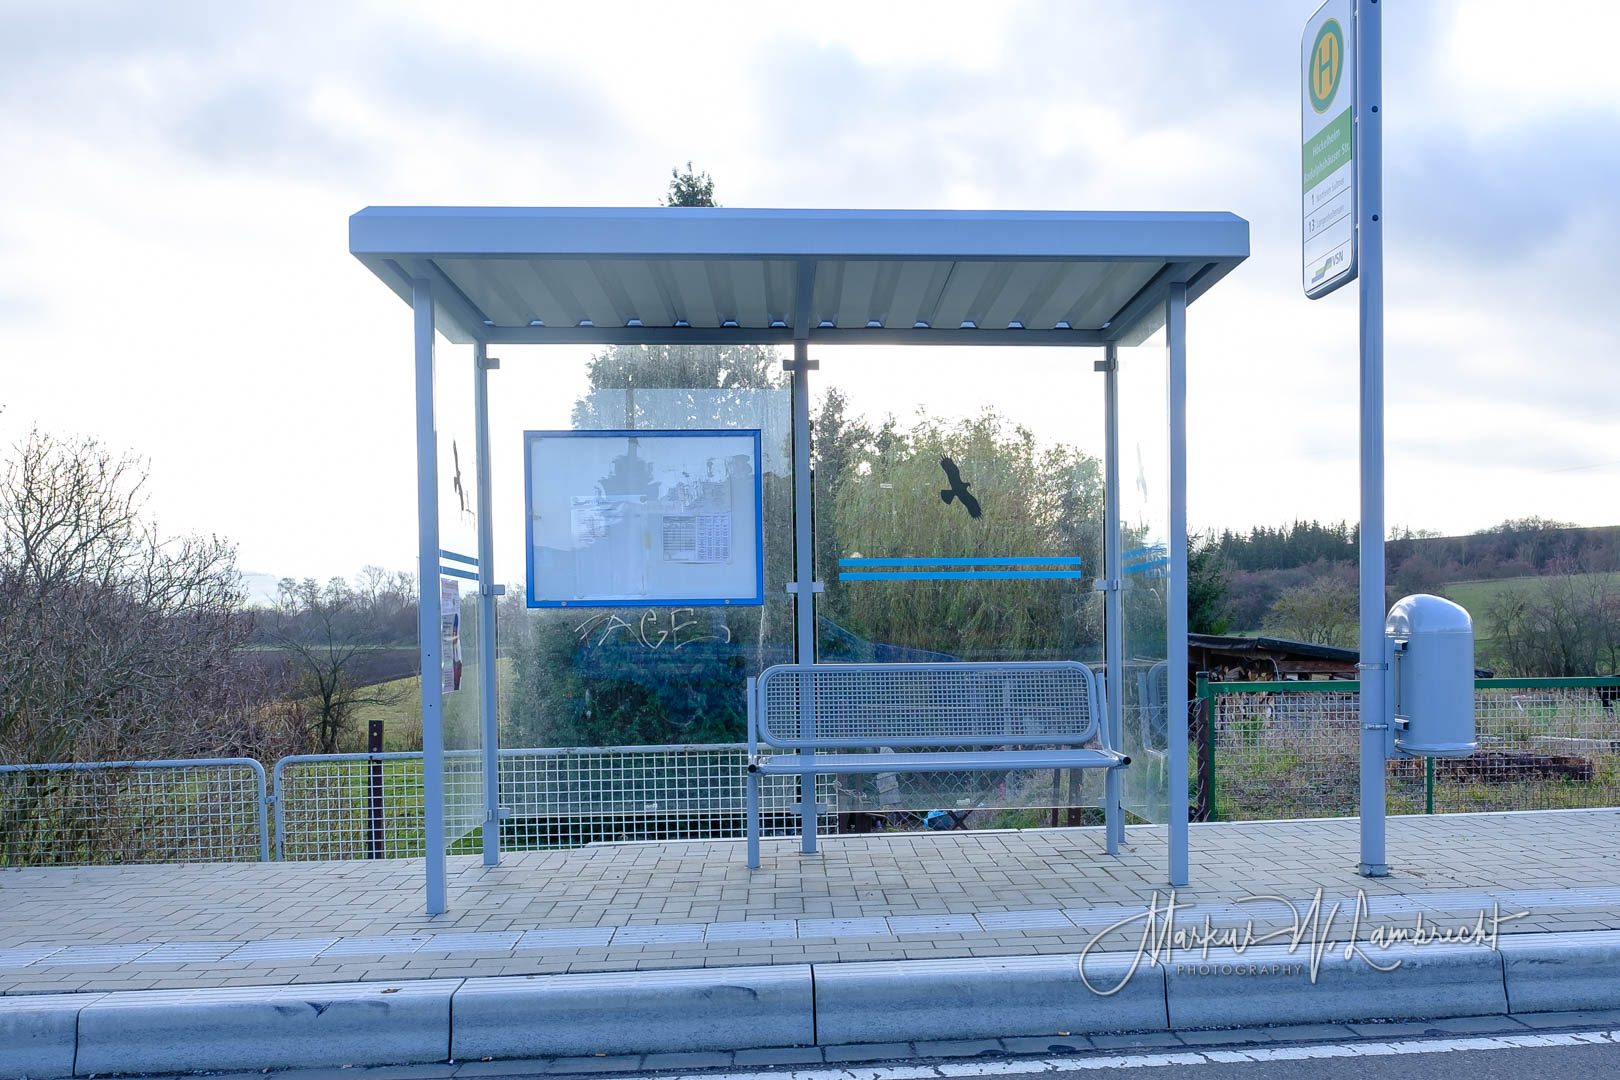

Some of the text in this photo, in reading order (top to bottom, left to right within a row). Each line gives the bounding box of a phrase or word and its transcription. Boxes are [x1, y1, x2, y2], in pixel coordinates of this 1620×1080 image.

[1318, 36, 1333, 95] H
[1308, 218, 1315, 233] 13
[1332, 250, 1344, 267] VSN
